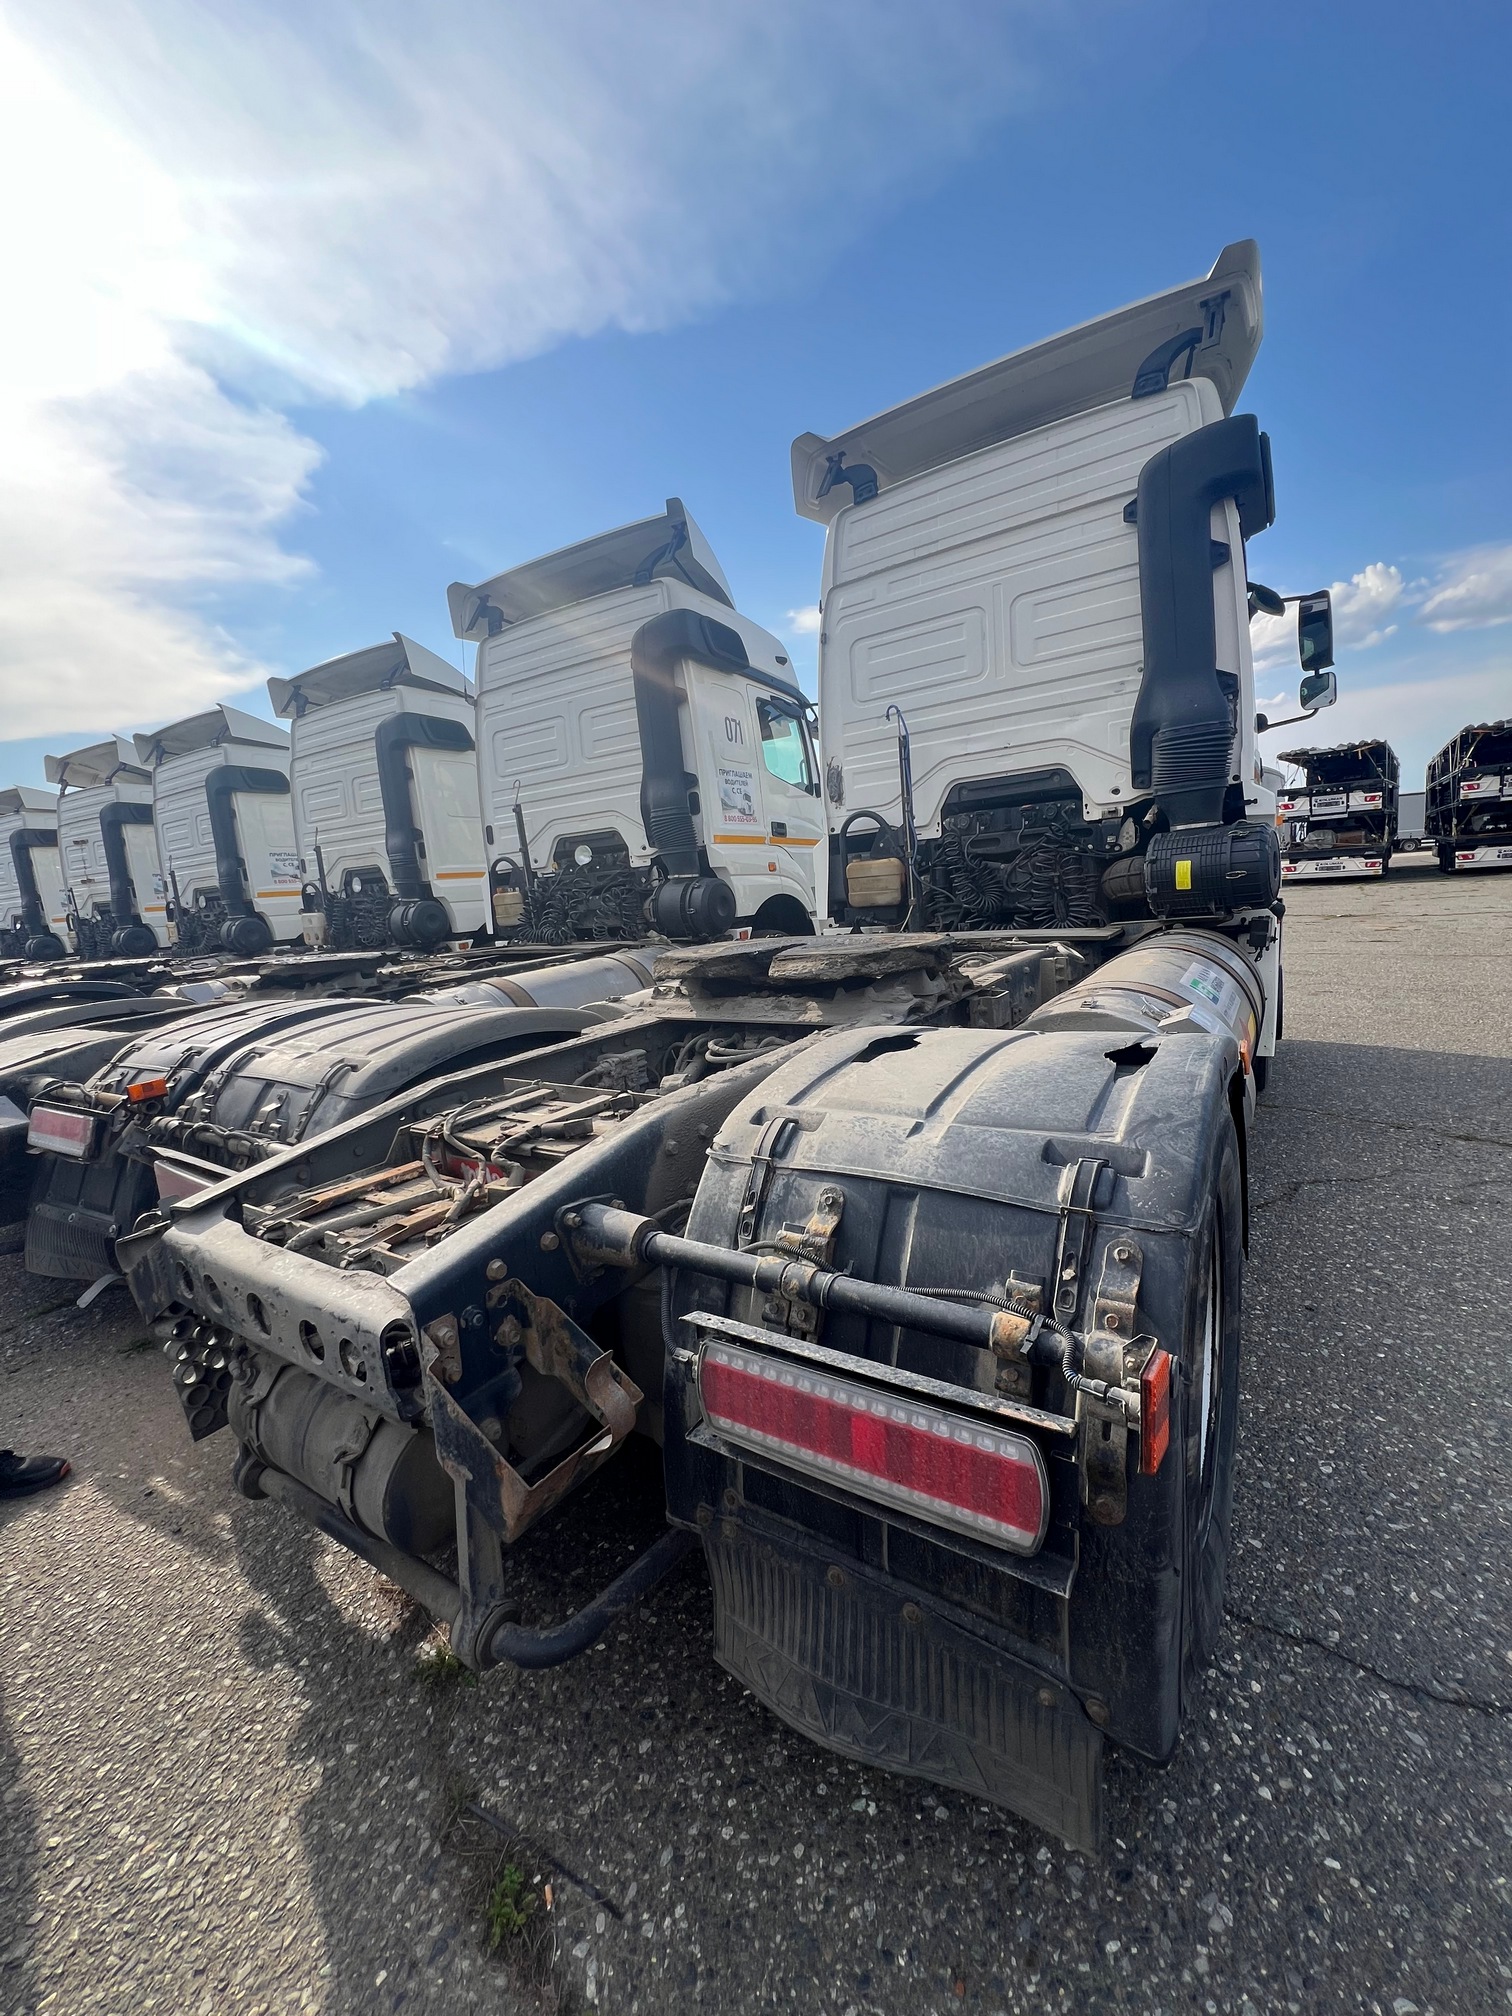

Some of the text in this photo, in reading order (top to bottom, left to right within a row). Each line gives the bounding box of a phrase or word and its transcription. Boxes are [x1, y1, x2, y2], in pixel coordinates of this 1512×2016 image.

[725, 716, 744, 745] 071
[719, 768, 752, 779] ПРИГЛАШАЕМ
[725, 778, 748, 787] ВОДИТЕЛЕЙ
